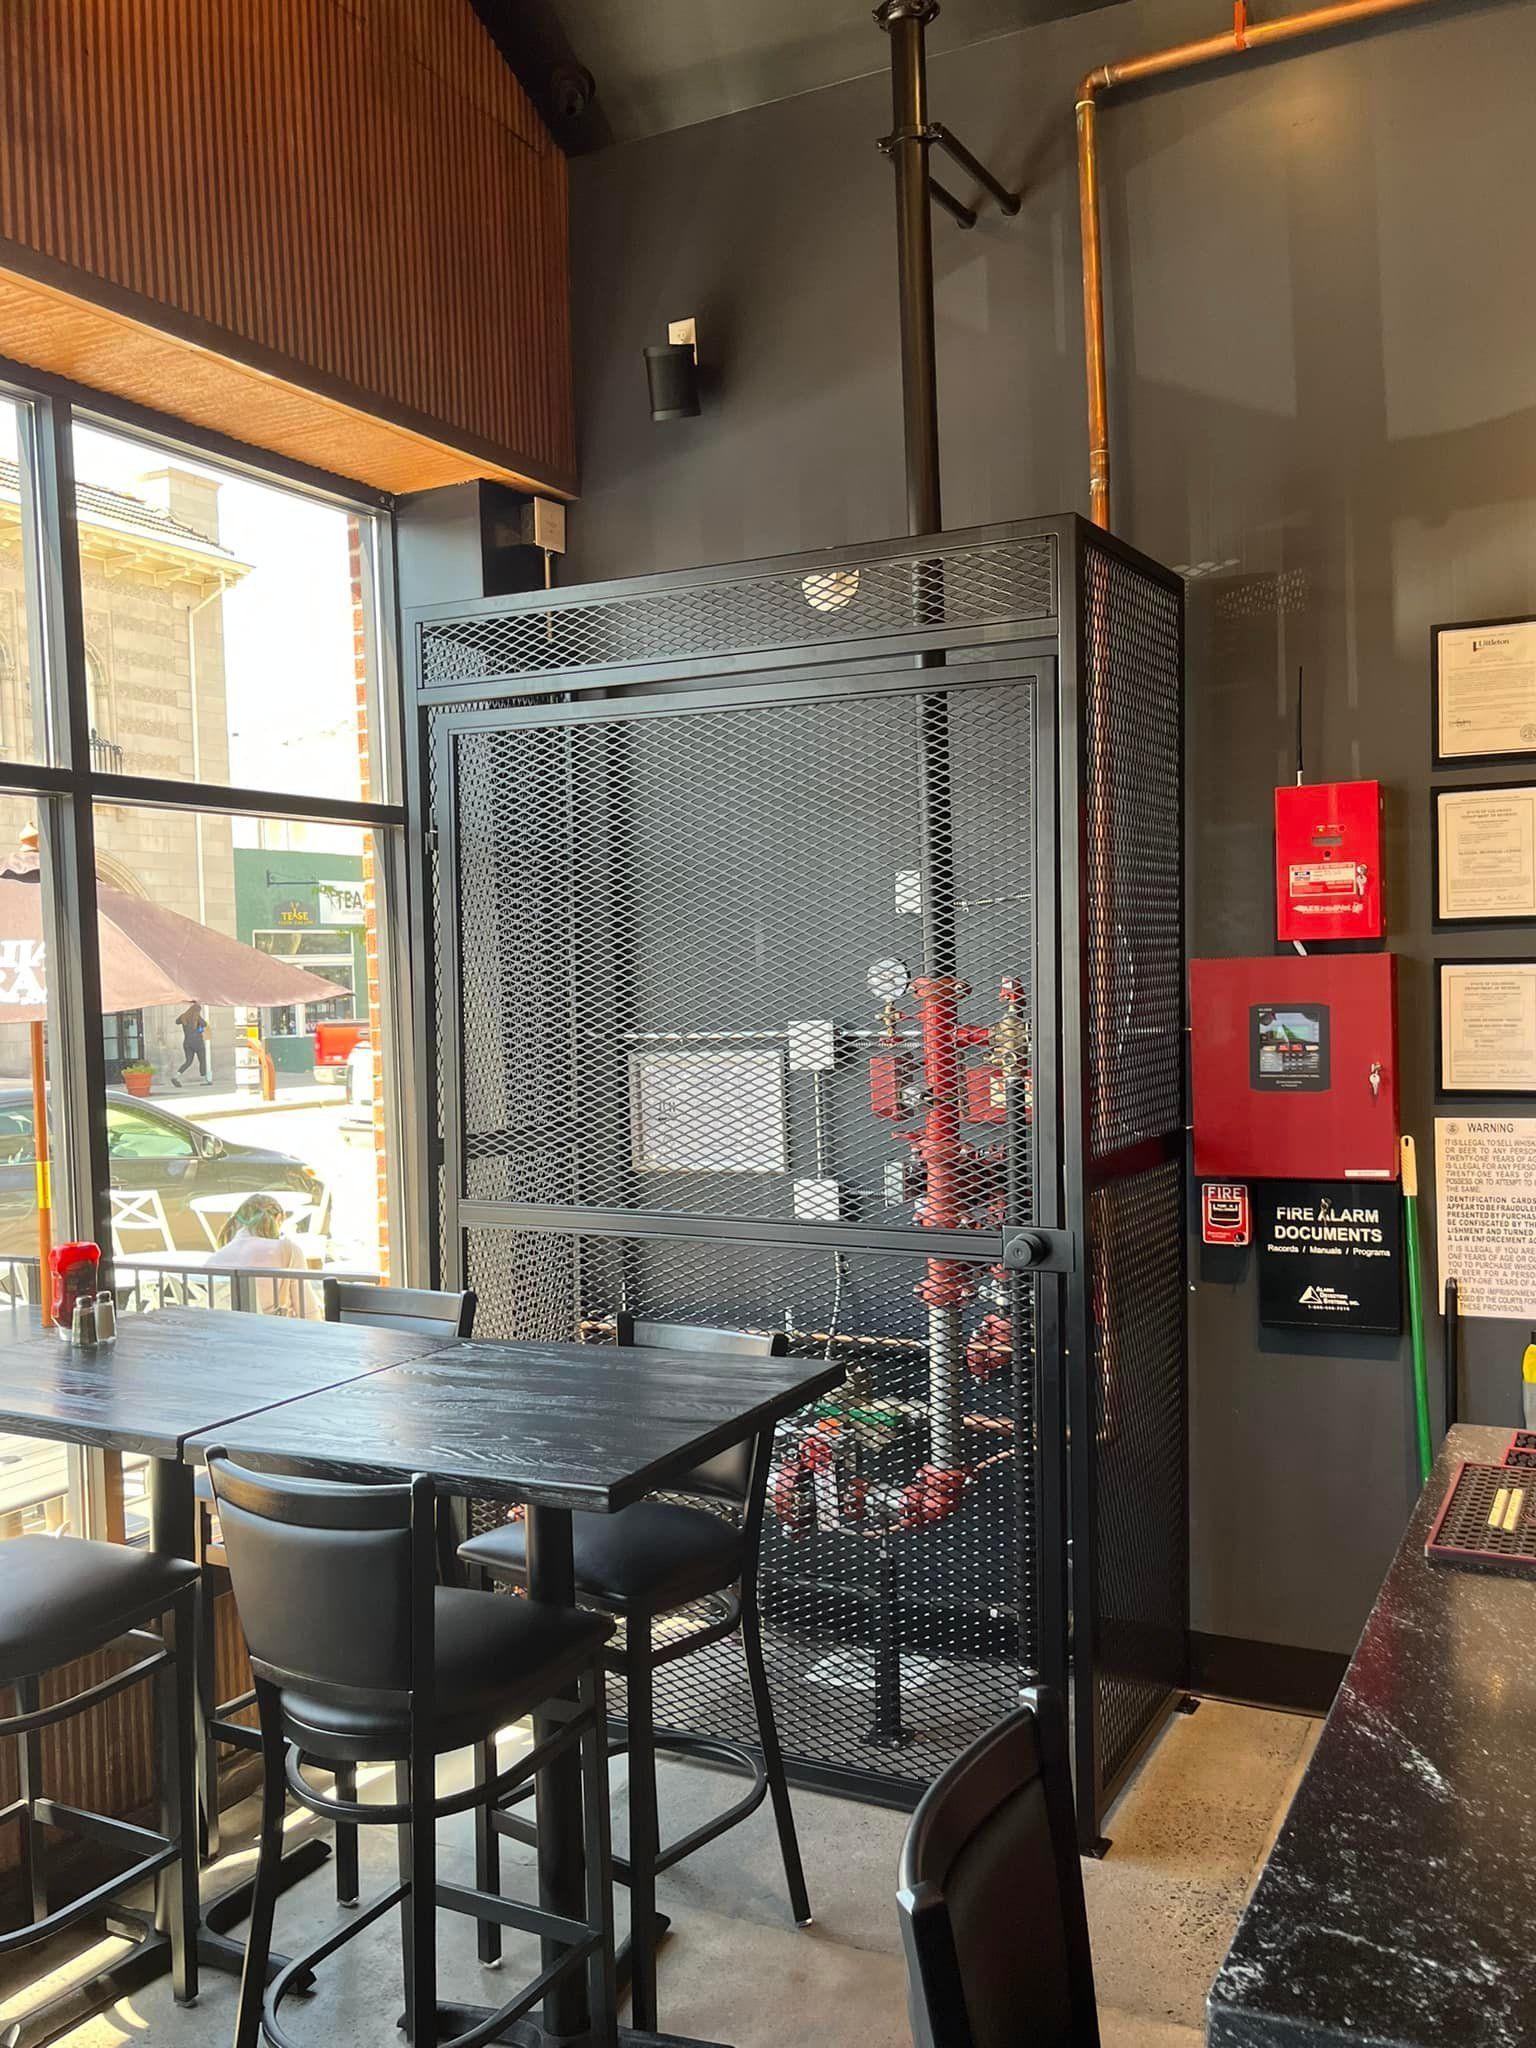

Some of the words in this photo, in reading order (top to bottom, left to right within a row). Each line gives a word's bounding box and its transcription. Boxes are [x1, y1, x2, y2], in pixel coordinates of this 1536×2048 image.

[1478, 638, 1510, 647] Littleton
[1467, 1123, 1514, 1133] WARNING
[1207, 1186, 1241, 1200] FIRE
[1276, 1207, 1314, 1221] FIRE
[1317, 1208, 1379, 1223] ALARM
[1459, 1219, 1509, 1227] CONFISCATED
[1274, 1225, 1383, 1242] DOCUMENTS
[1472, 1236, 1526, 1244] ENFORCEMENT
[1267, 1244, 1299, 1253] Records
[1309, 1245, 1342, 1255] Manuals
[1352, 1247, 1391, 1257] Programs
